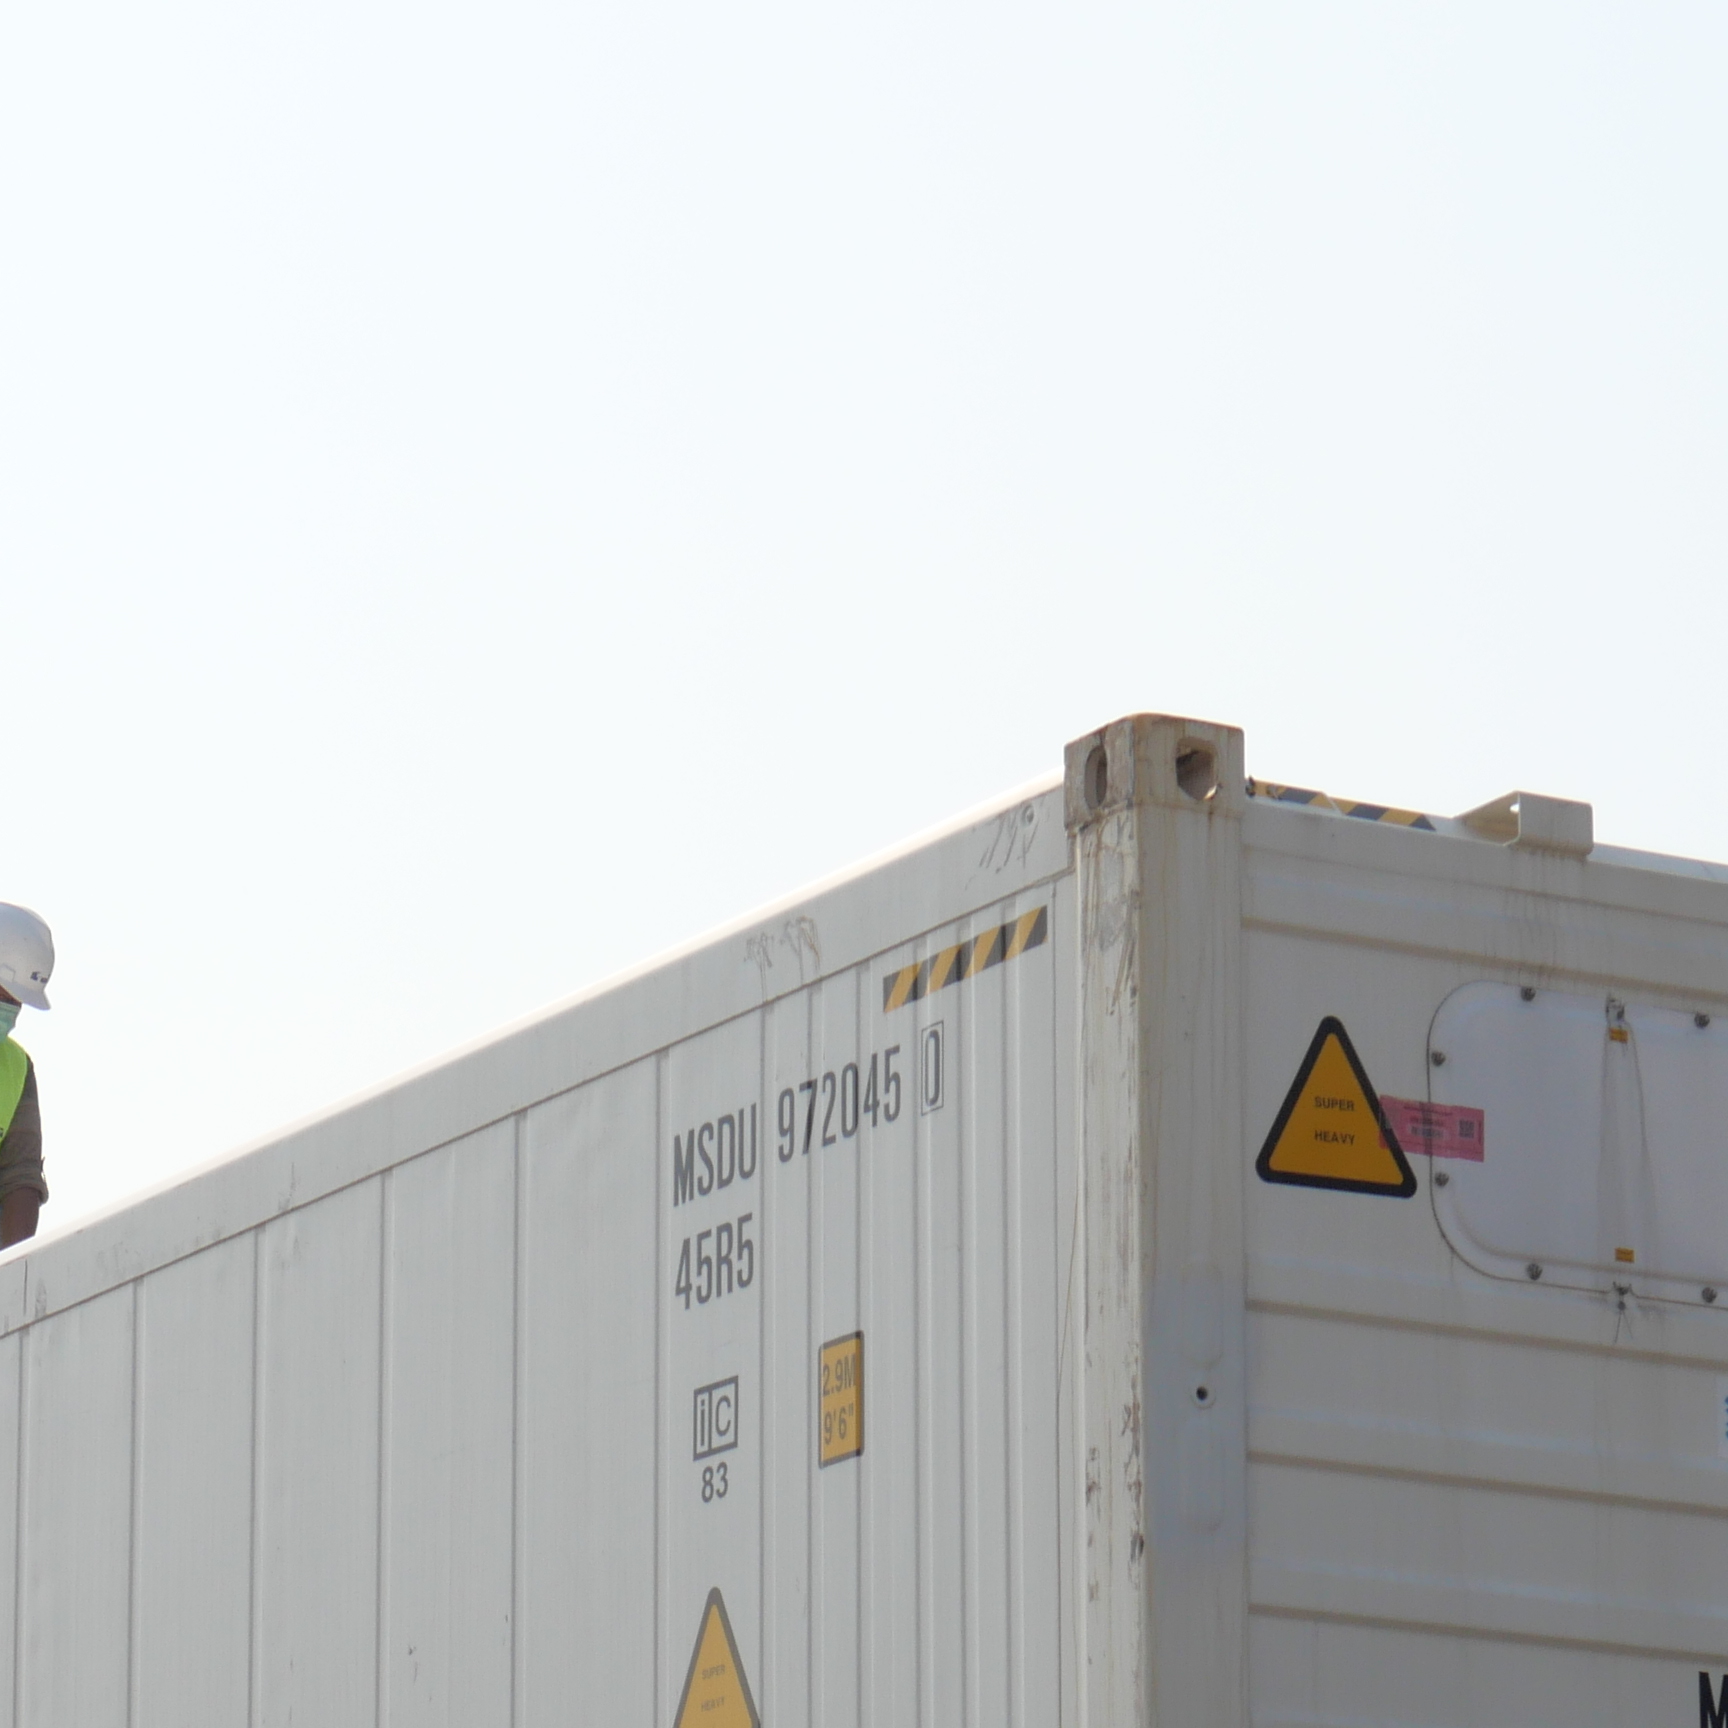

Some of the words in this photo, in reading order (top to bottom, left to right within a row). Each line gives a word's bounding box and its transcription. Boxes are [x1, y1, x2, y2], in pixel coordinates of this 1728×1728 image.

[673, 1102, 757, 1208] MSDU
[777, 1043, 902, 1164] 972045
[924, 1028, 942, 1107] 0
[1314, 1095, 1355, 1111] SUPER
[1314, 1129, 1355, 1146] HEAVY
[675, 1212, 754, 1311] 45R5
[823, 1354, 856, 1396] 2.9M
[701, 1462, 728, 1503] 83
